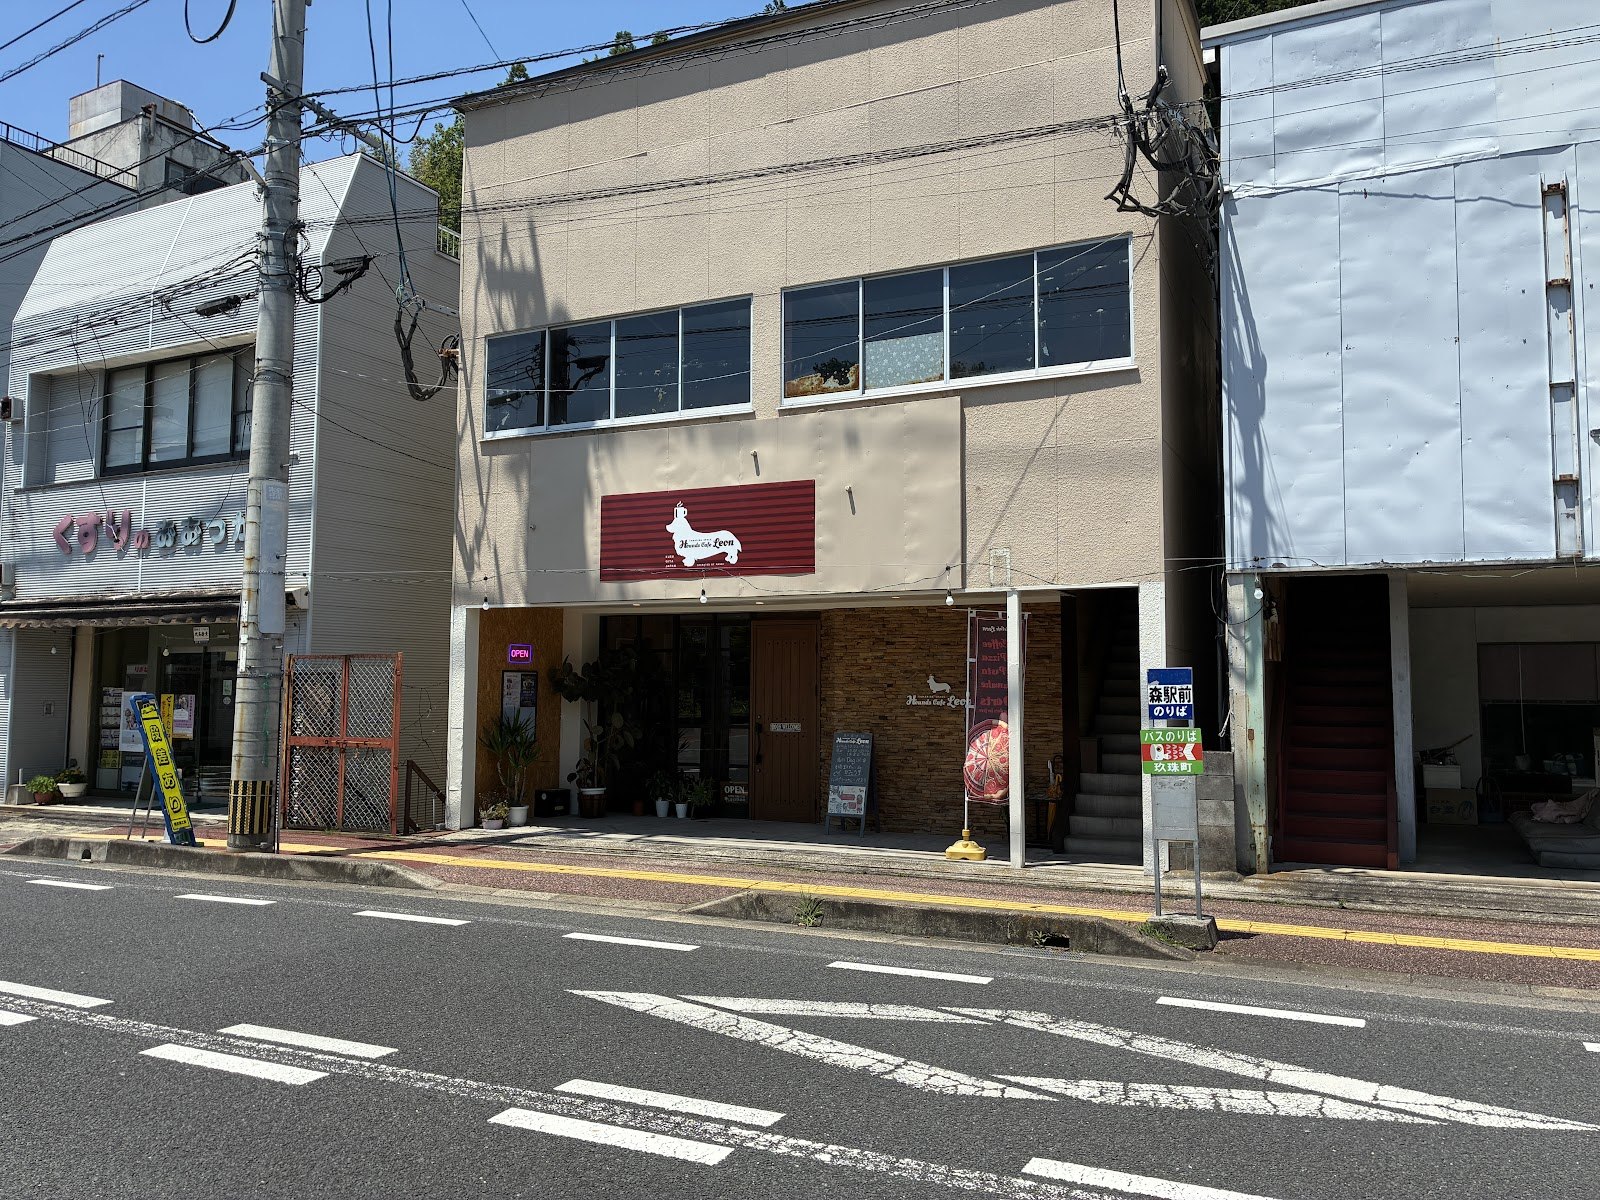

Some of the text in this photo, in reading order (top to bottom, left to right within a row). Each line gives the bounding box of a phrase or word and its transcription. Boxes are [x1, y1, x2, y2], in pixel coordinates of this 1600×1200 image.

[679, 539, 701, 549] Hounds
[713, 537, 734, 549] Leon
[511, 649, 529, 658] OPEN
[906, 694, 932, 706] Hounds
[933, 698, 946, 707] Cafe
[1149, 686, 1191, 704] 森駅前
[1154, 706, 1188, 717] のりば
[1144, 730, 1197, 742] バスのりば
[150, 724, 182, 814] 段差あり
[1154, 762, 1193, 773] 玖珠町
[724, 785, 745, 794] OPEN
